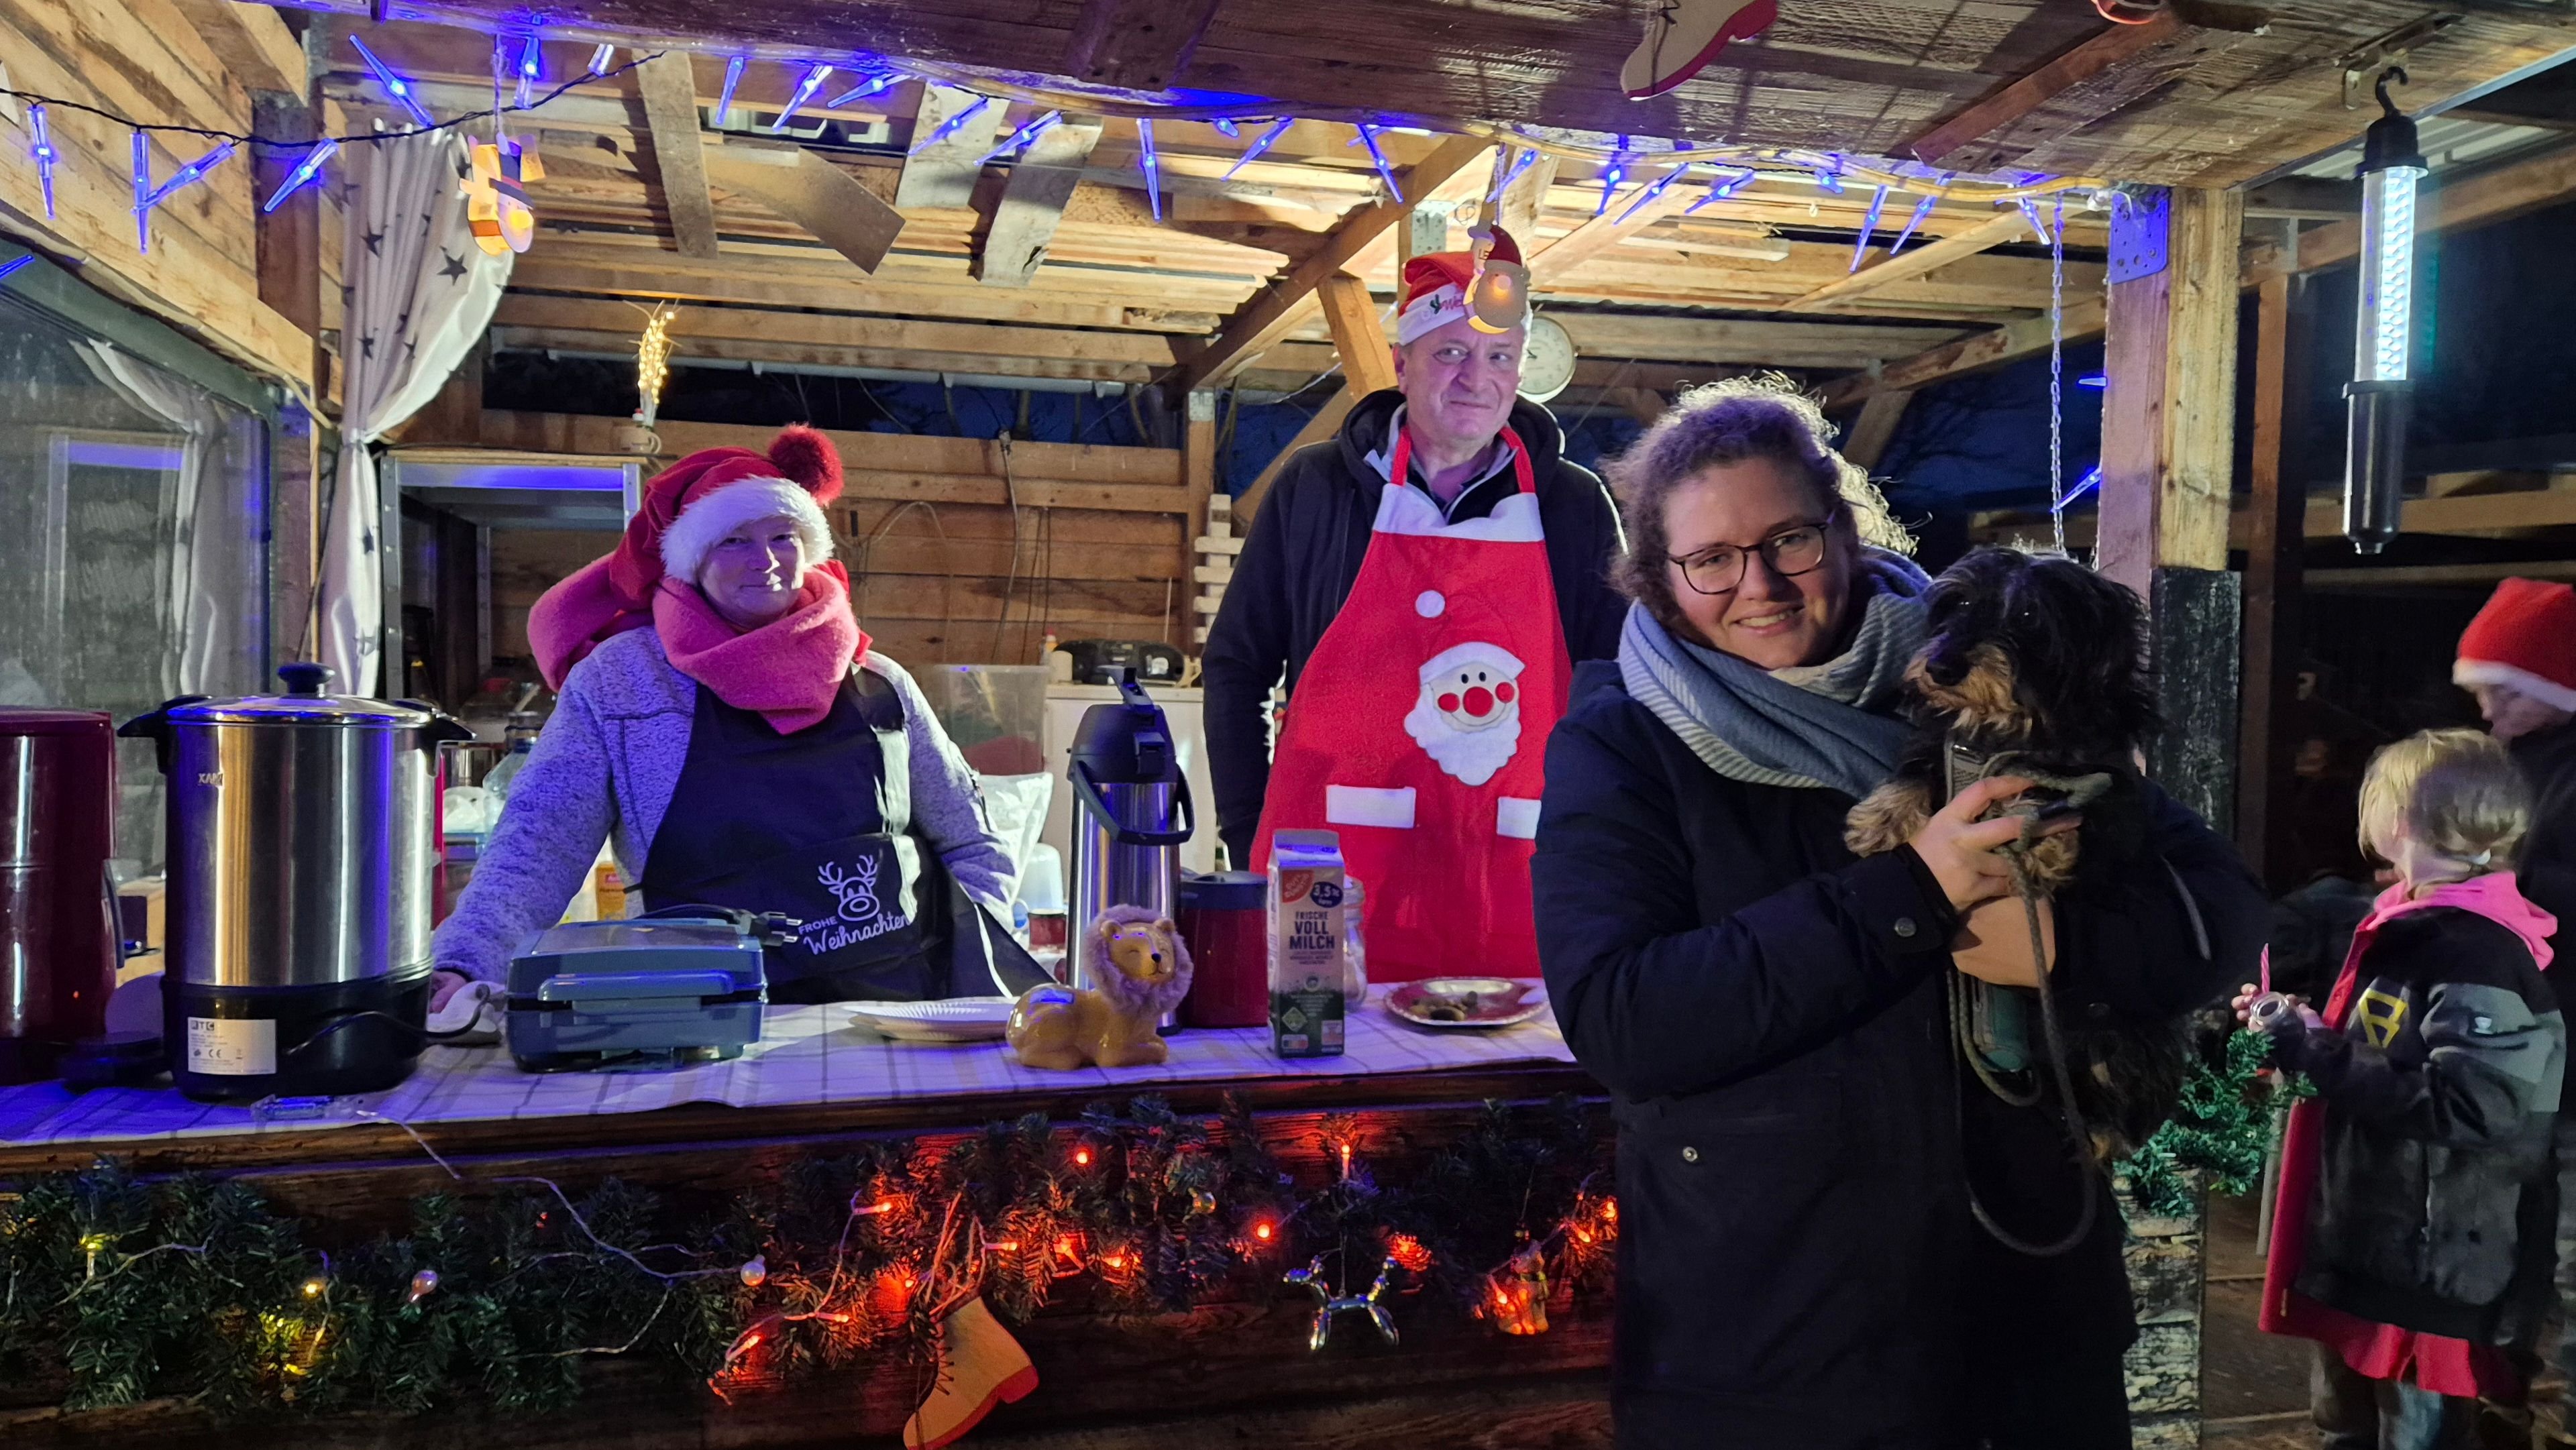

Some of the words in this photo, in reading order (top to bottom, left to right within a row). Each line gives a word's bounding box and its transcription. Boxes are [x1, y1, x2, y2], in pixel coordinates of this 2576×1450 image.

[1295, 911, 1329, 920] FRISCHE
[798, 916, 838, 935] FROHE
[1295, 921, 1329, 935] VOLL
[803, 911, 910, 955] Weihnachten
[1289, 936, 1335, 950] MILCH
